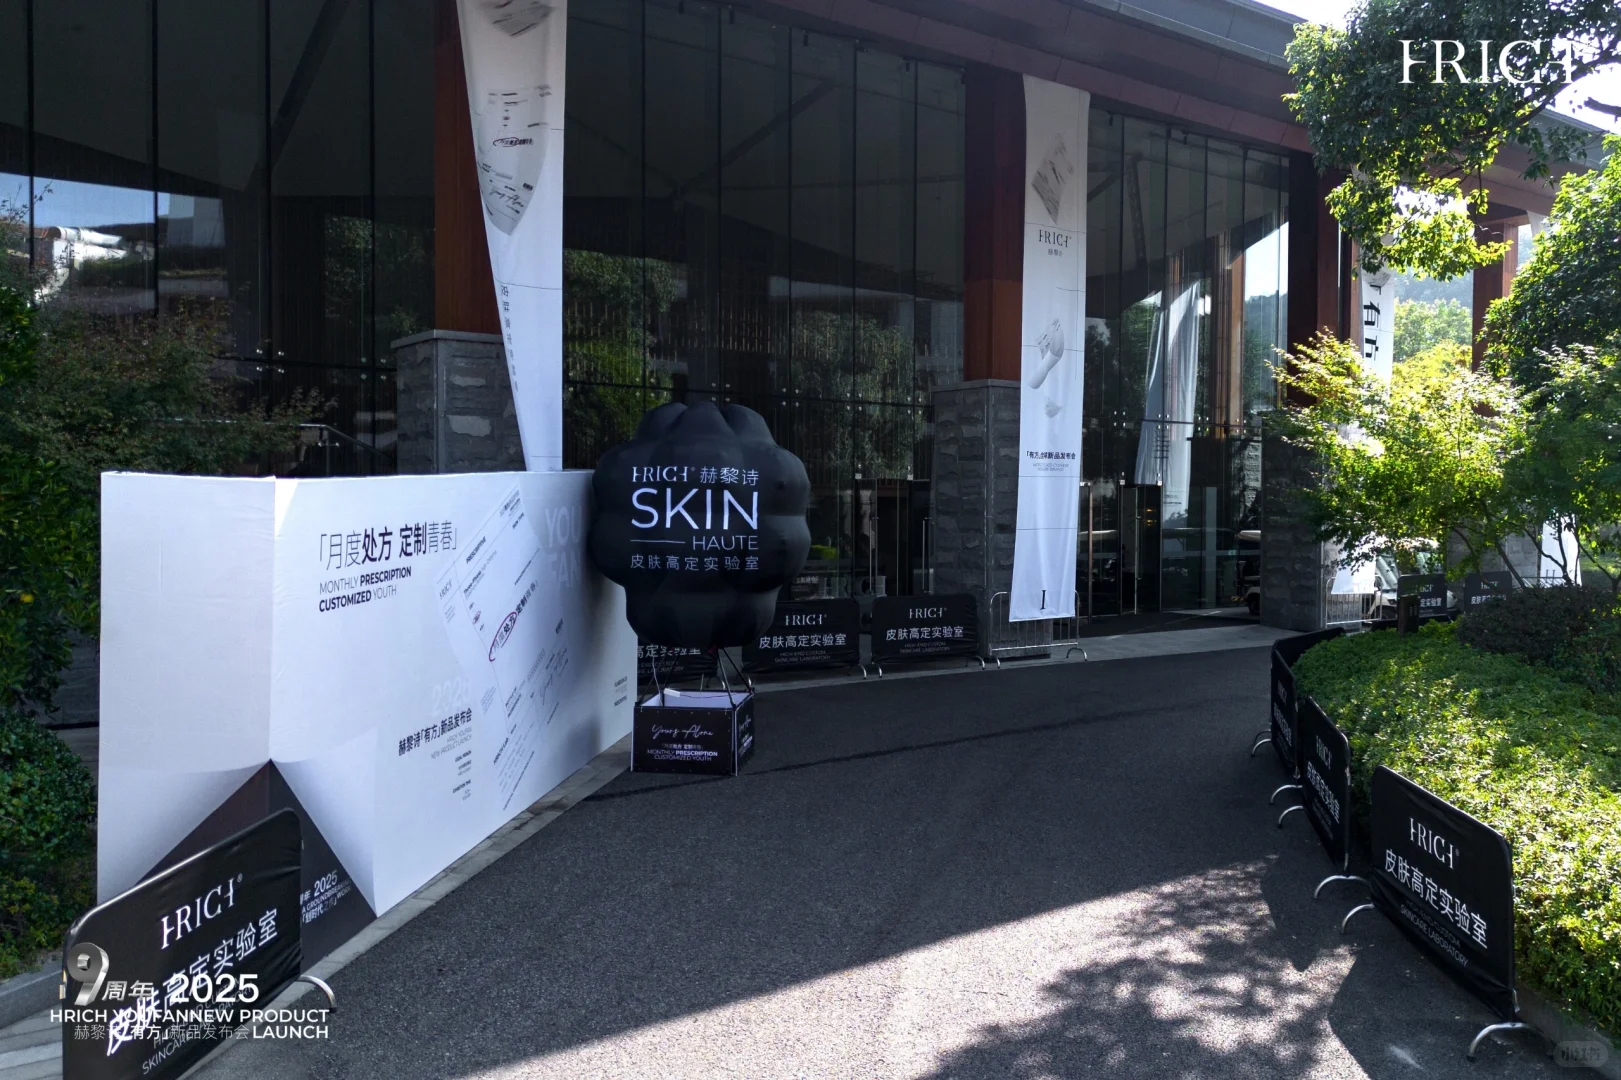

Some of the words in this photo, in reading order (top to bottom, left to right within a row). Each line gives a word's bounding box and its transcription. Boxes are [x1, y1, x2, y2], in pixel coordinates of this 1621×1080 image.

[700, 466, 759, 486] 赫黎诗
[631, 487, 759, 530] SKIN
[692, 535, 759, 551] HAUTE
[630, 554, 759, 571] 皮肤高定实验室
[319, 576, 359, 595] MONTHLY
[359, 566, 412, 587] PRESCRIPTION
[319, 590, 372, 612] CUSTOMIZED
[373, 585, 397, 600] YOUTH
[759, 633, 847, 649] 皮肤高定实验室
[886, 626, 964, 640] 皮肤高定实验室
[313, 870, 338, 897] 2025
[1384, 848, 1488, 949] 皮肤高定实验室
[1428, 928, 1468, 967] LABORATORY
